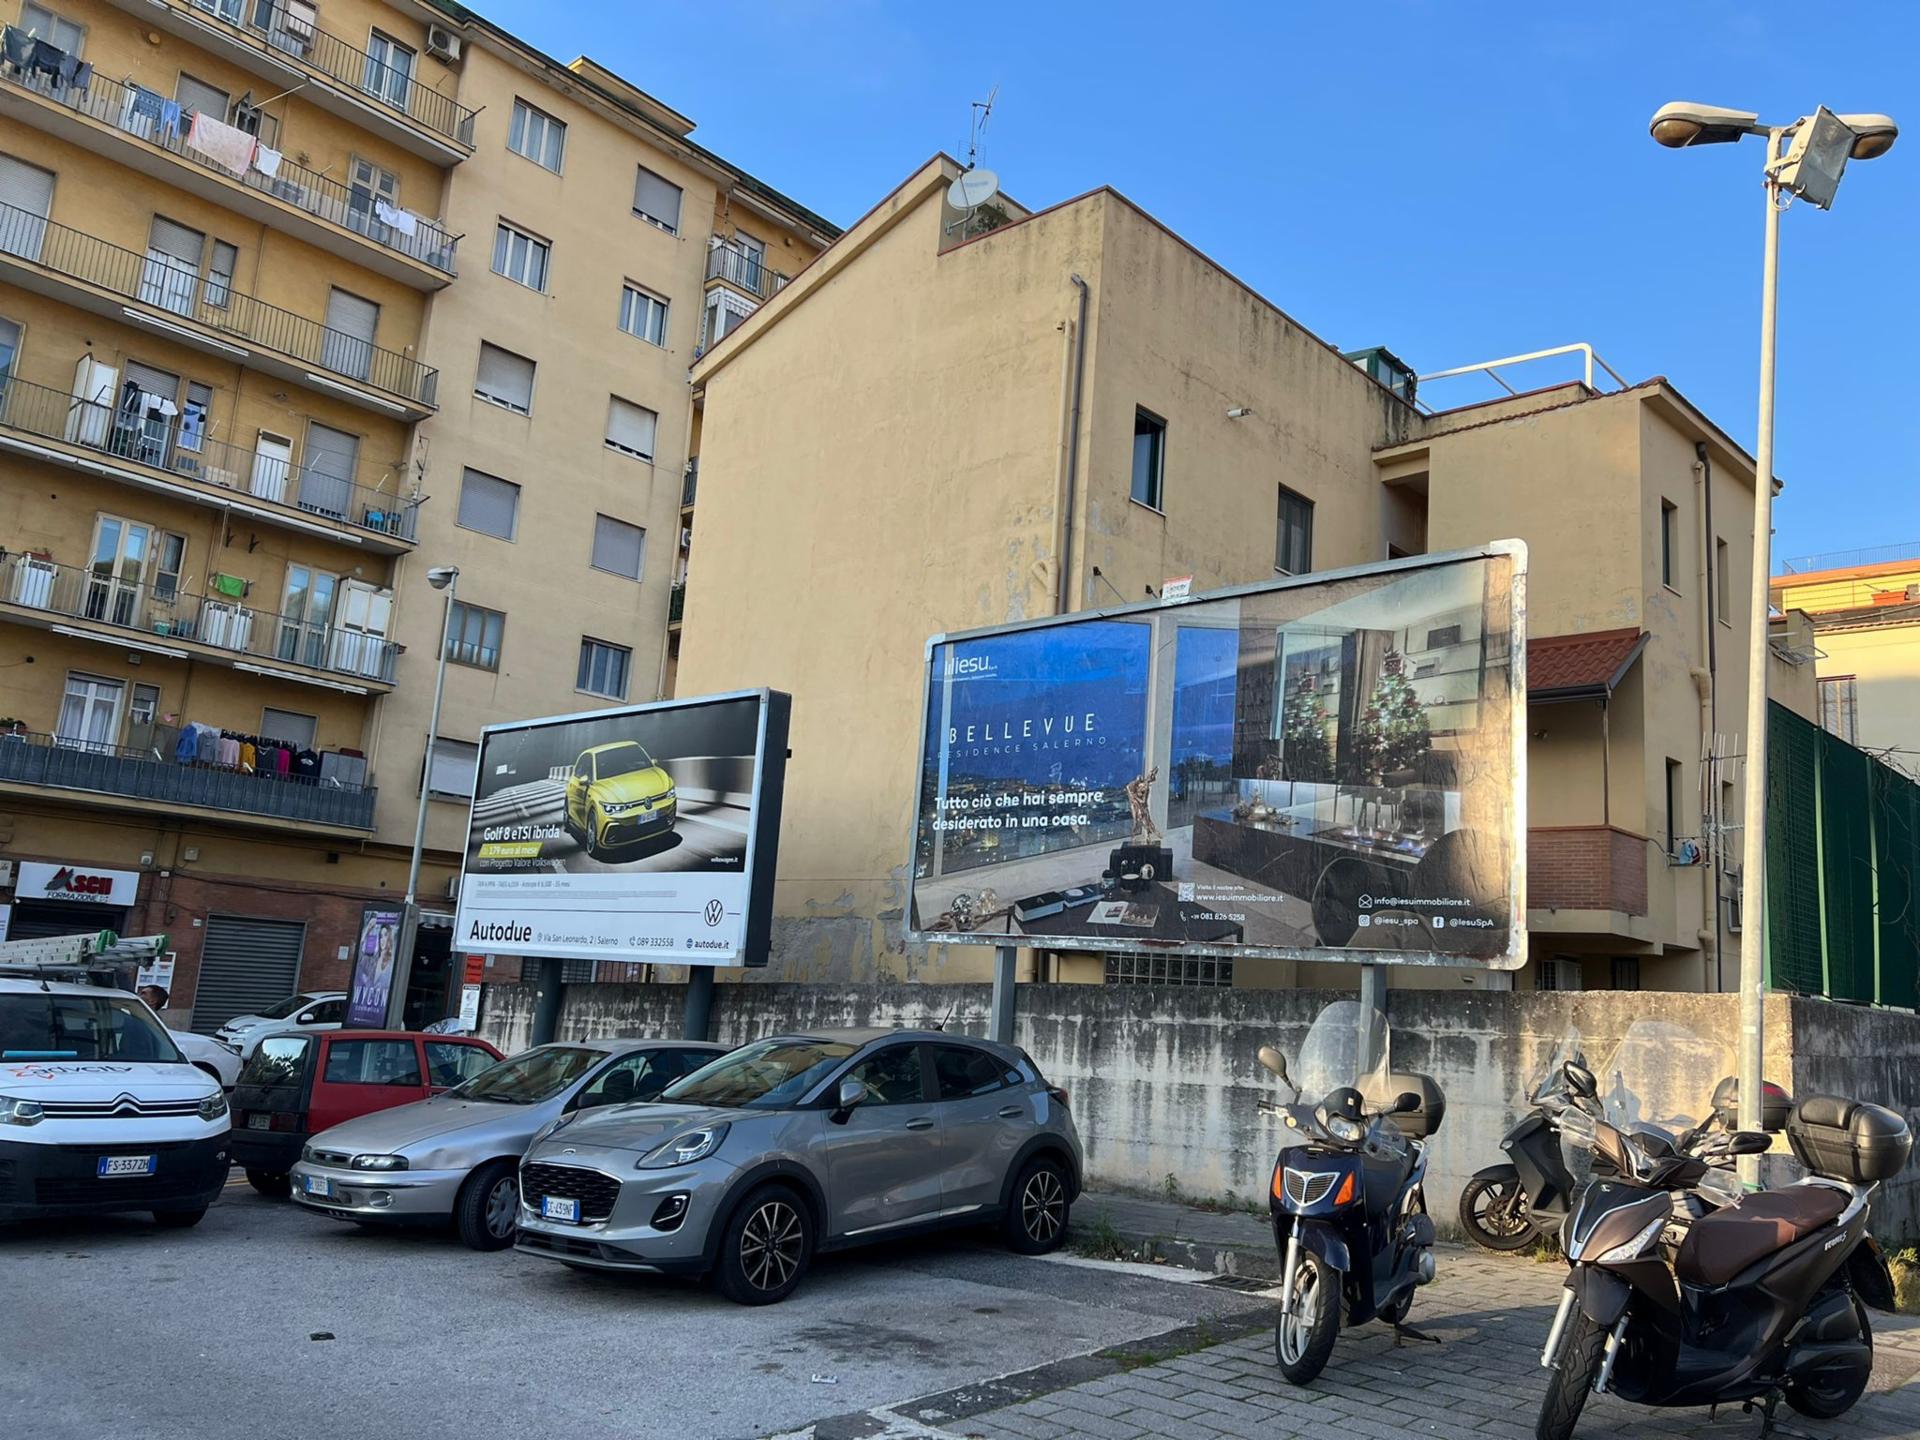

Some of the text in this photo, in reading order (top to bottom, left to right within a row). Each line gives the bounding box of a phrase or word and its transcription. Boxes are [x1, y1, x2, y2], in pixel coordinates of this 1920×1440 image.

[949, 713, 1095, 744] BELLEVUE
[1032, 737, 1106, 751] SALERNO
[934, 797, 968, 810] Tutto
[972, 793, 991, 808] ciò
[995, 793, 1019, 807] che
[1023, 790, 1045, 806] hai
[932, 814, 1091, 831] desiderato in una casa.
[483, 827, 503, 840] Golf
[503, 827, 511, 840] 8
[532, 824, 560, 839] ibrida
[1374, 896, 1471, 907] info@iesuimmobiliare.it
[470, 919, 532, 942] Autodue
[597, 936, 619, 945] Salerno
[637, 937, 649, 946] 089
[694, 940, 729, 949] autodue.it
